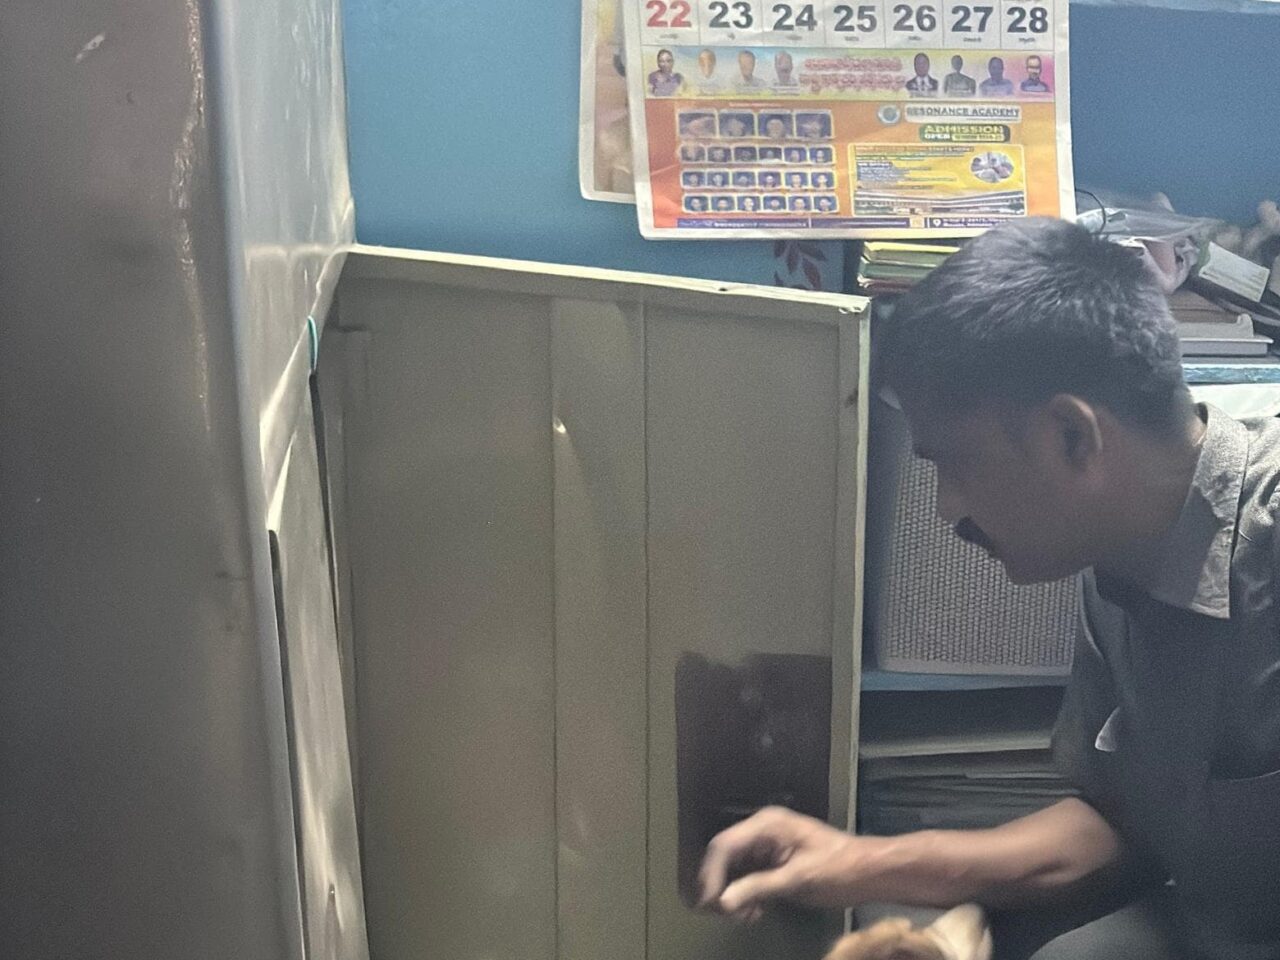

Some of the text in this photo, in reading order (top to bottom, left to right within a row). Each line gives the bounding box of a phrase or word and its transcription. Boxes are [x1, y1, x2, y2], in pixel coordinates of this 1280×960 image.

[646, 1, 1048, 33] 22 23 24 25 26 27 28
[906, 107, 1020, 117] RESONANCE ACADEMY
[924, 125, 1004, 134] ADMISSION
